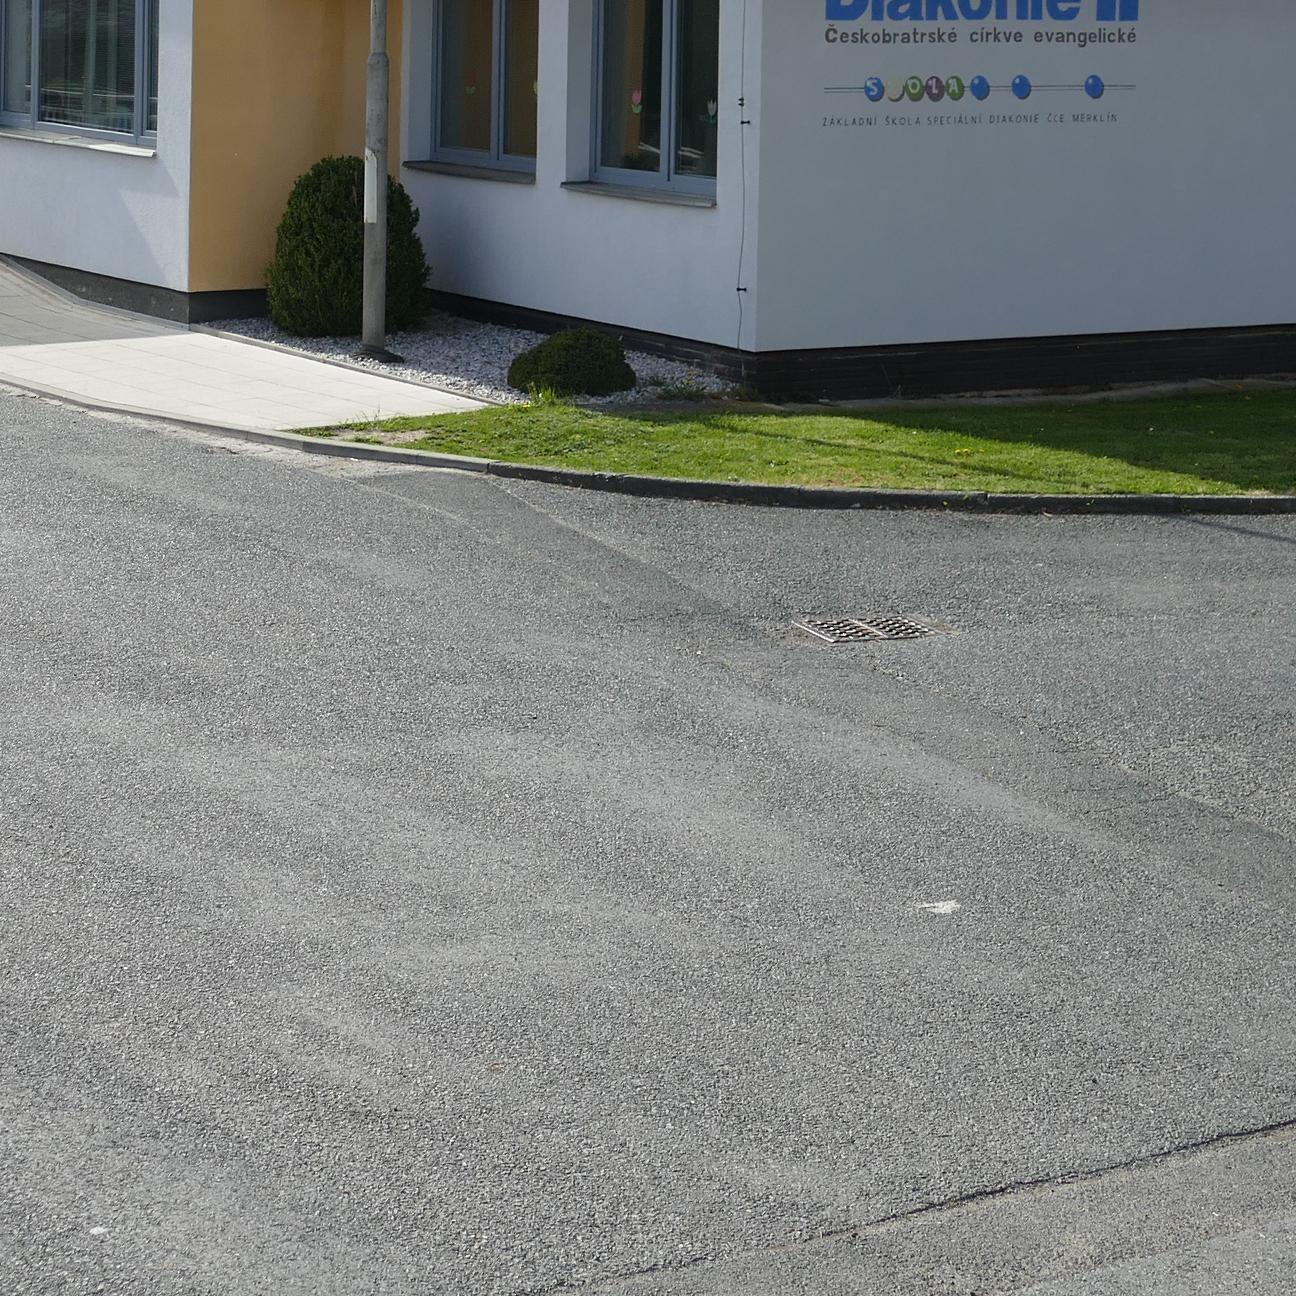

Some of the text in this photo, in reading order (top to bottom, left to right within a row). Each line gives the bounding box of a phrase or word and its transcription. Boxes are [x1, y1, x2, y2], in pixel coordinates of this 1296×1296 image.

[824, 23, 1137, 48] Českobratrské církve evangelické
[865, 76, 962, 99] SOLA
[884, 114, 921, 127] ŠKOLA
[989, 113, 1040, 124] DIAKONIE
